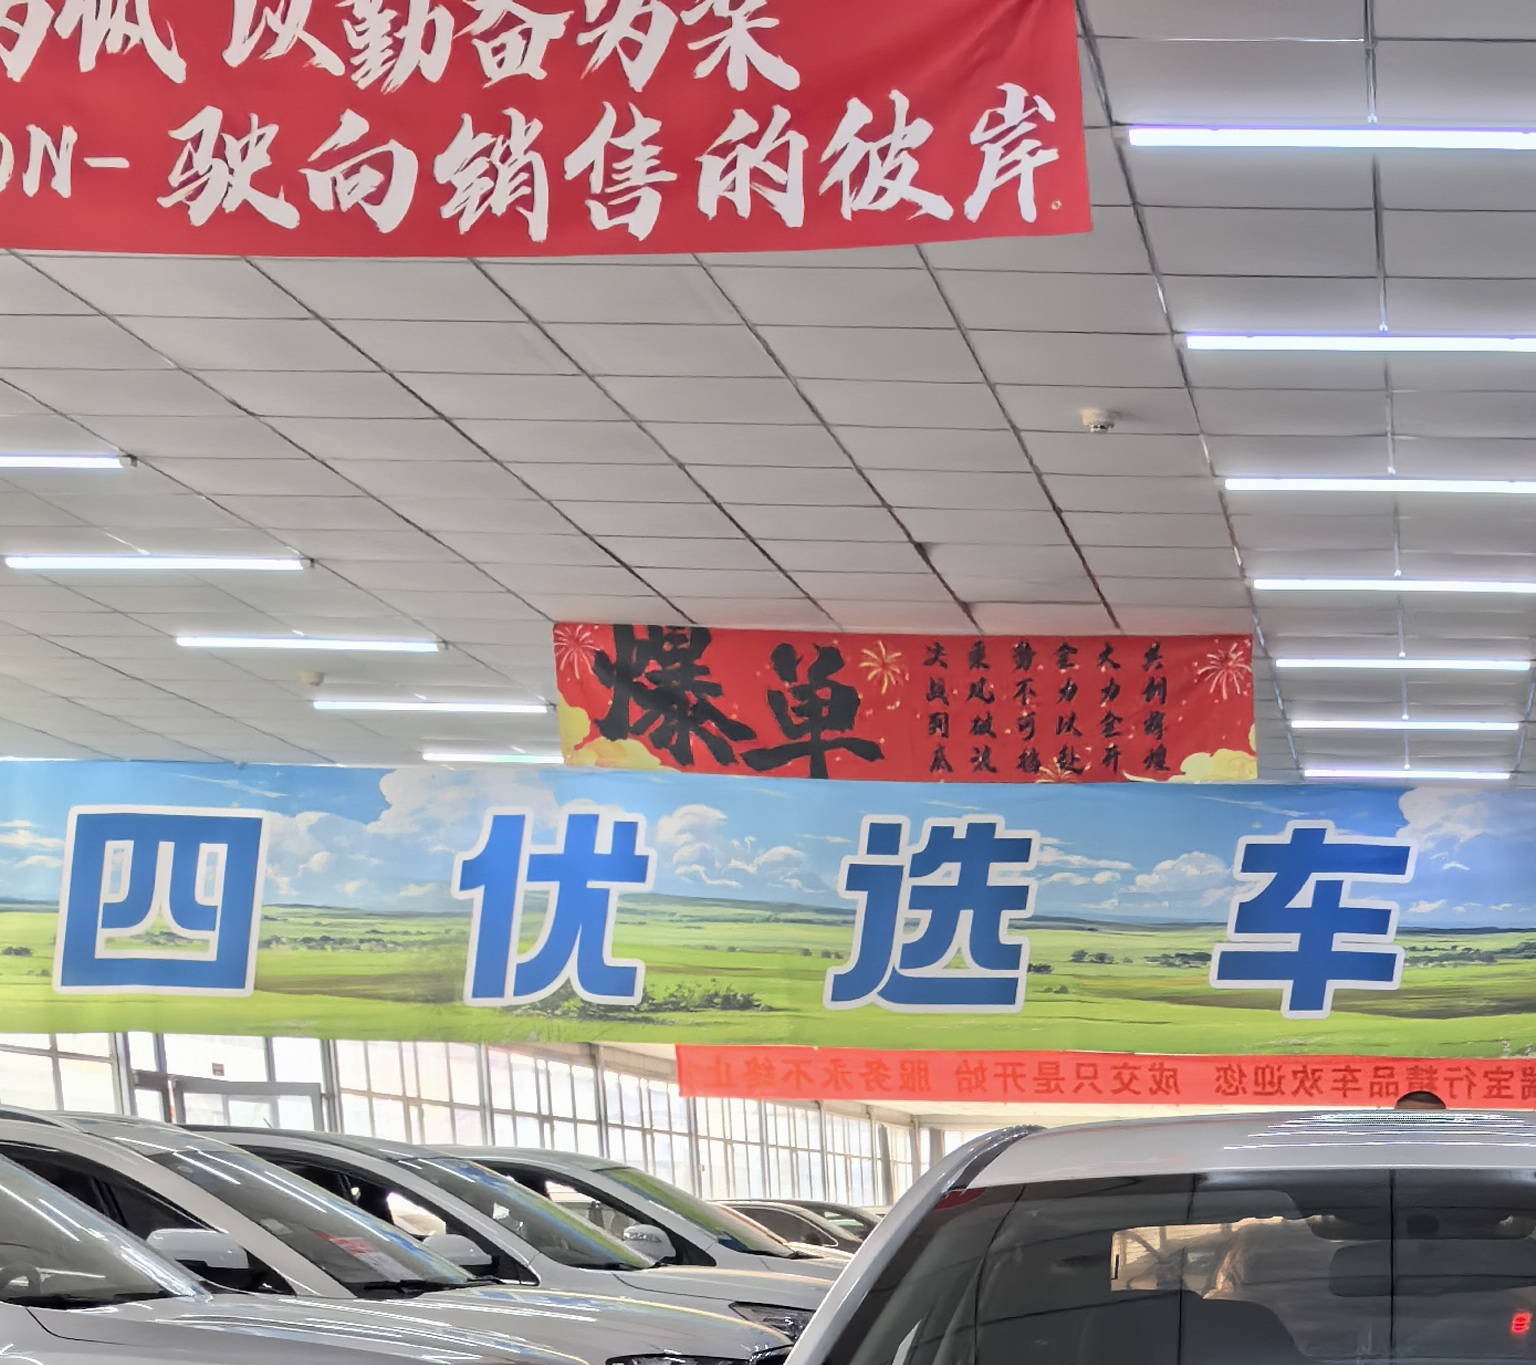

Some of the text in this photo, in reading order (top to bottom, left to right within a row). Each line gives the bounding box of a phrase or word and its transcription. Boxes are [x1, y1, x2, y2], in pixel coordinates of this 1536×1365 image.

[157, 83, 1058, 241] 驶向销售的彼岸
[594, 624, 886, 779] 爆单
[966, 640, 997, 773] 乘风破浪
[1055, 641, 1083, 775] 全力以赴
[1143, 640, 1170, 772] 共创辉煌
[54, 805, 1414, 1019] 四优选车
